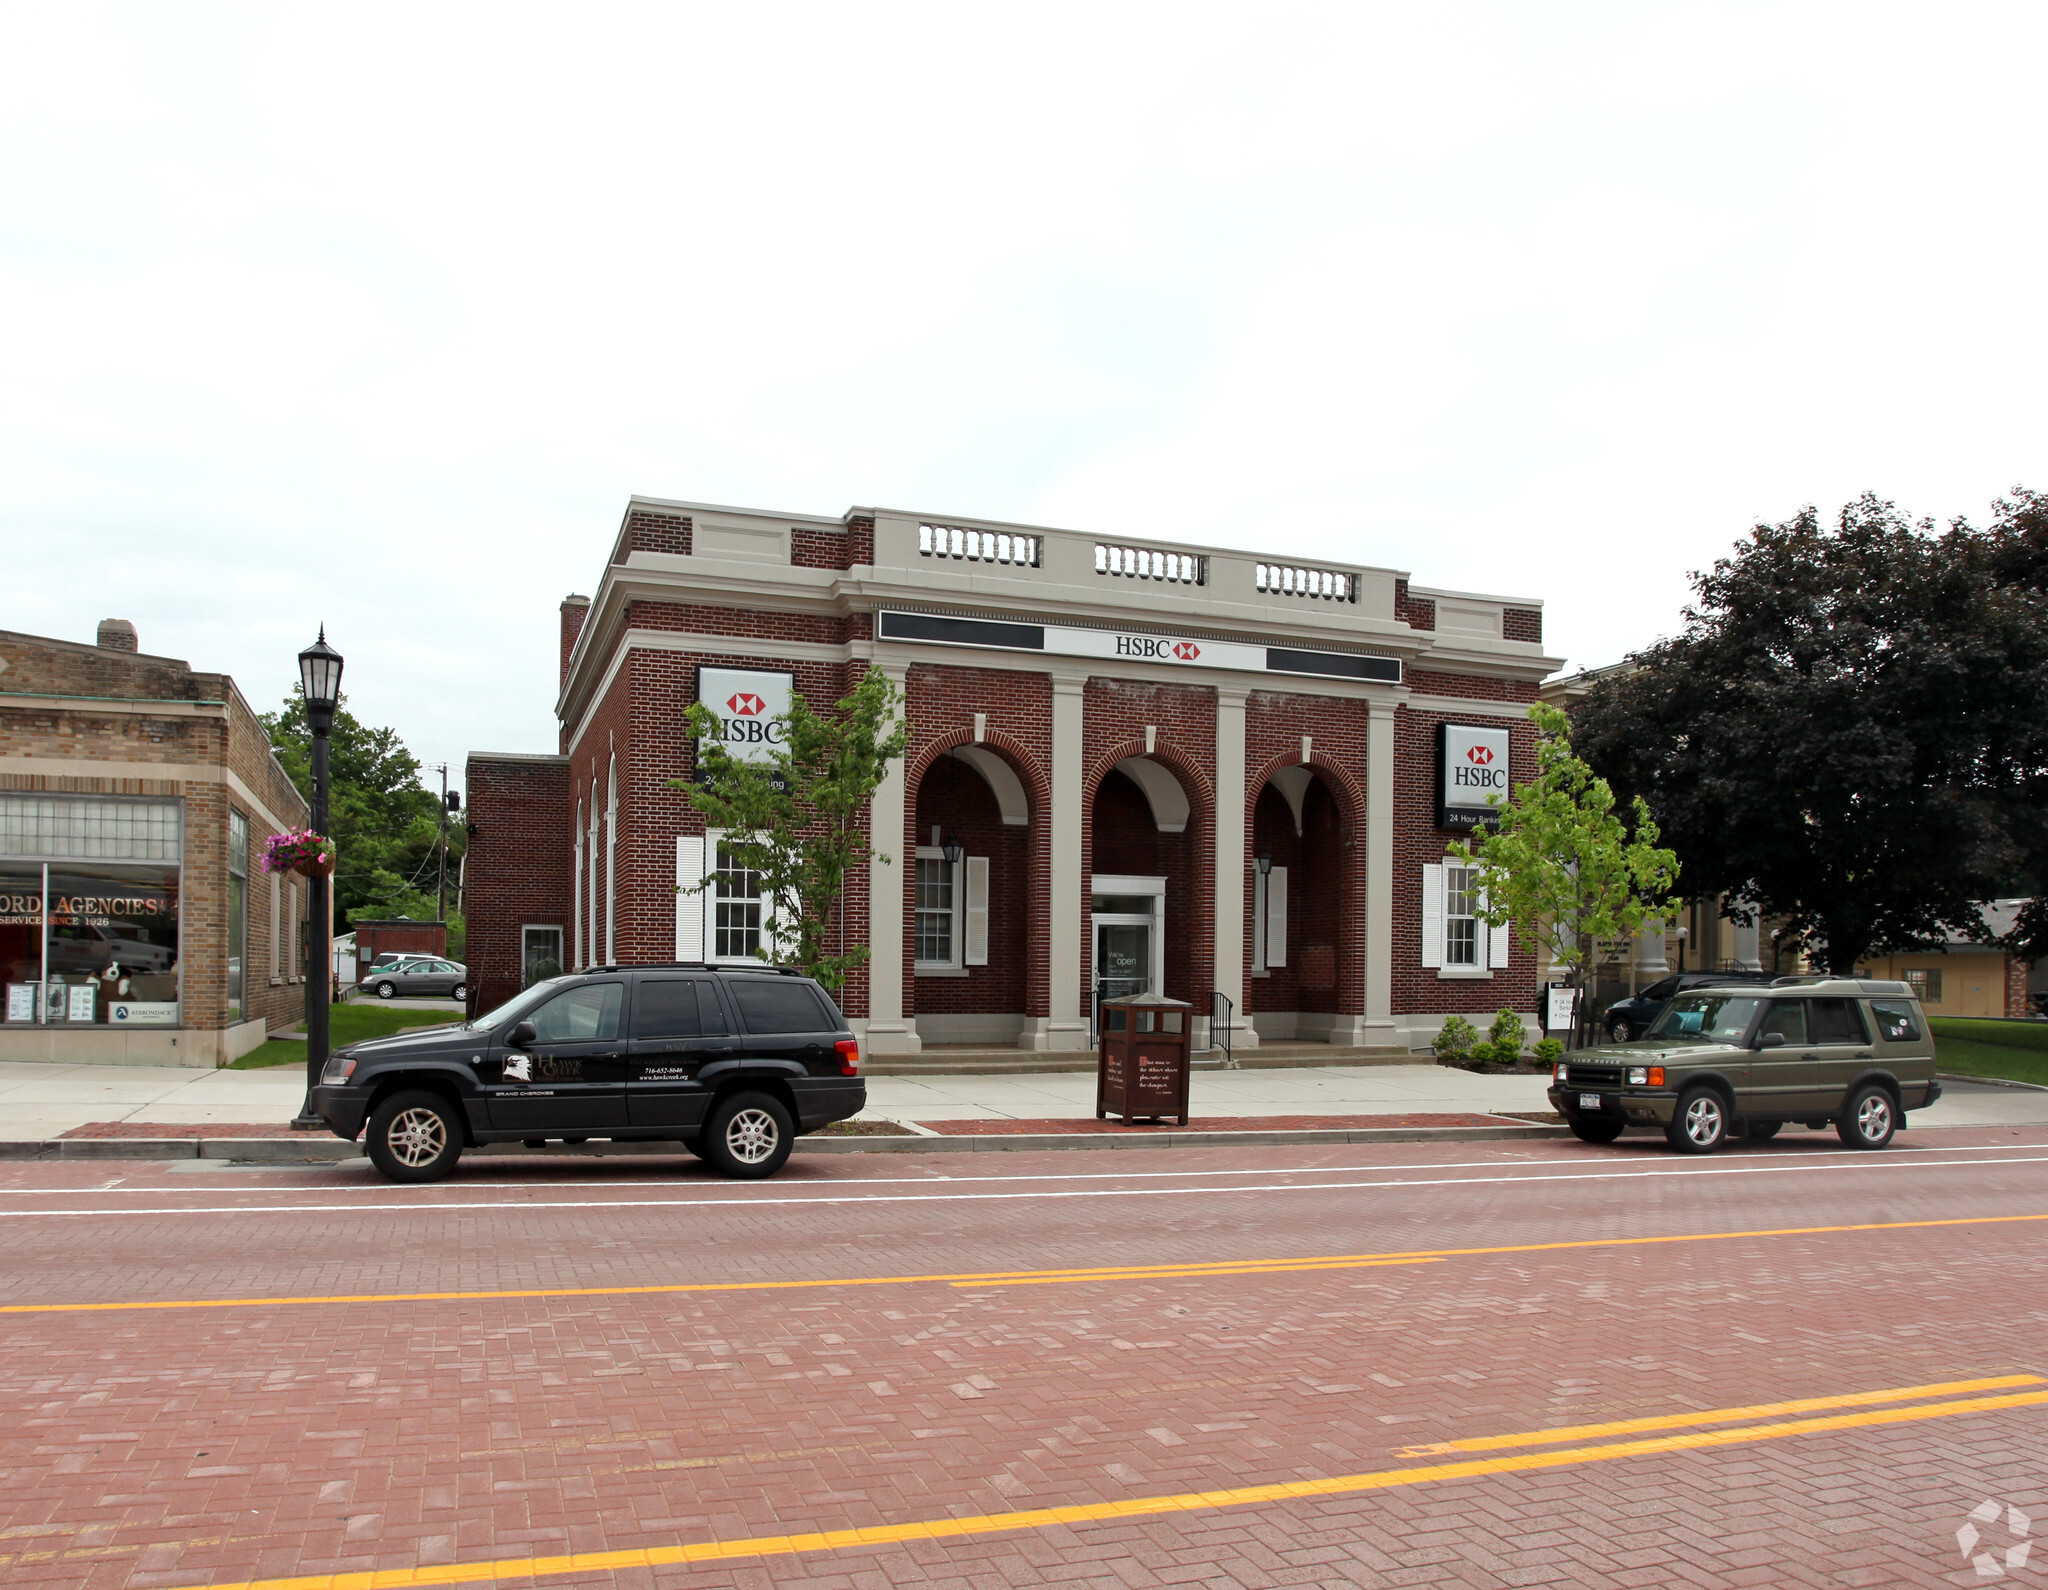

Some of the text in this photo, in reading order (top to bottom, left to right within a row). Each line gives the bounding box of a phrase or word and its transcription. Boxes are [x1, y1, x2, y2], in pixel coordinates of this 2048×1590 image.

[1115, 636, 1170, 658] HSBC
[1454, 766, 1505, 788] HSBC
[1449, 814, 1501, 824] 24 Hour Bankin
[56, 897, 157, 915] AGENCIES
[0, 916, 109, 926] SERVICE SINCE 1926
[1117, 958, 1137, 967] open
[538, 1054, 583, 1067] HAWK
